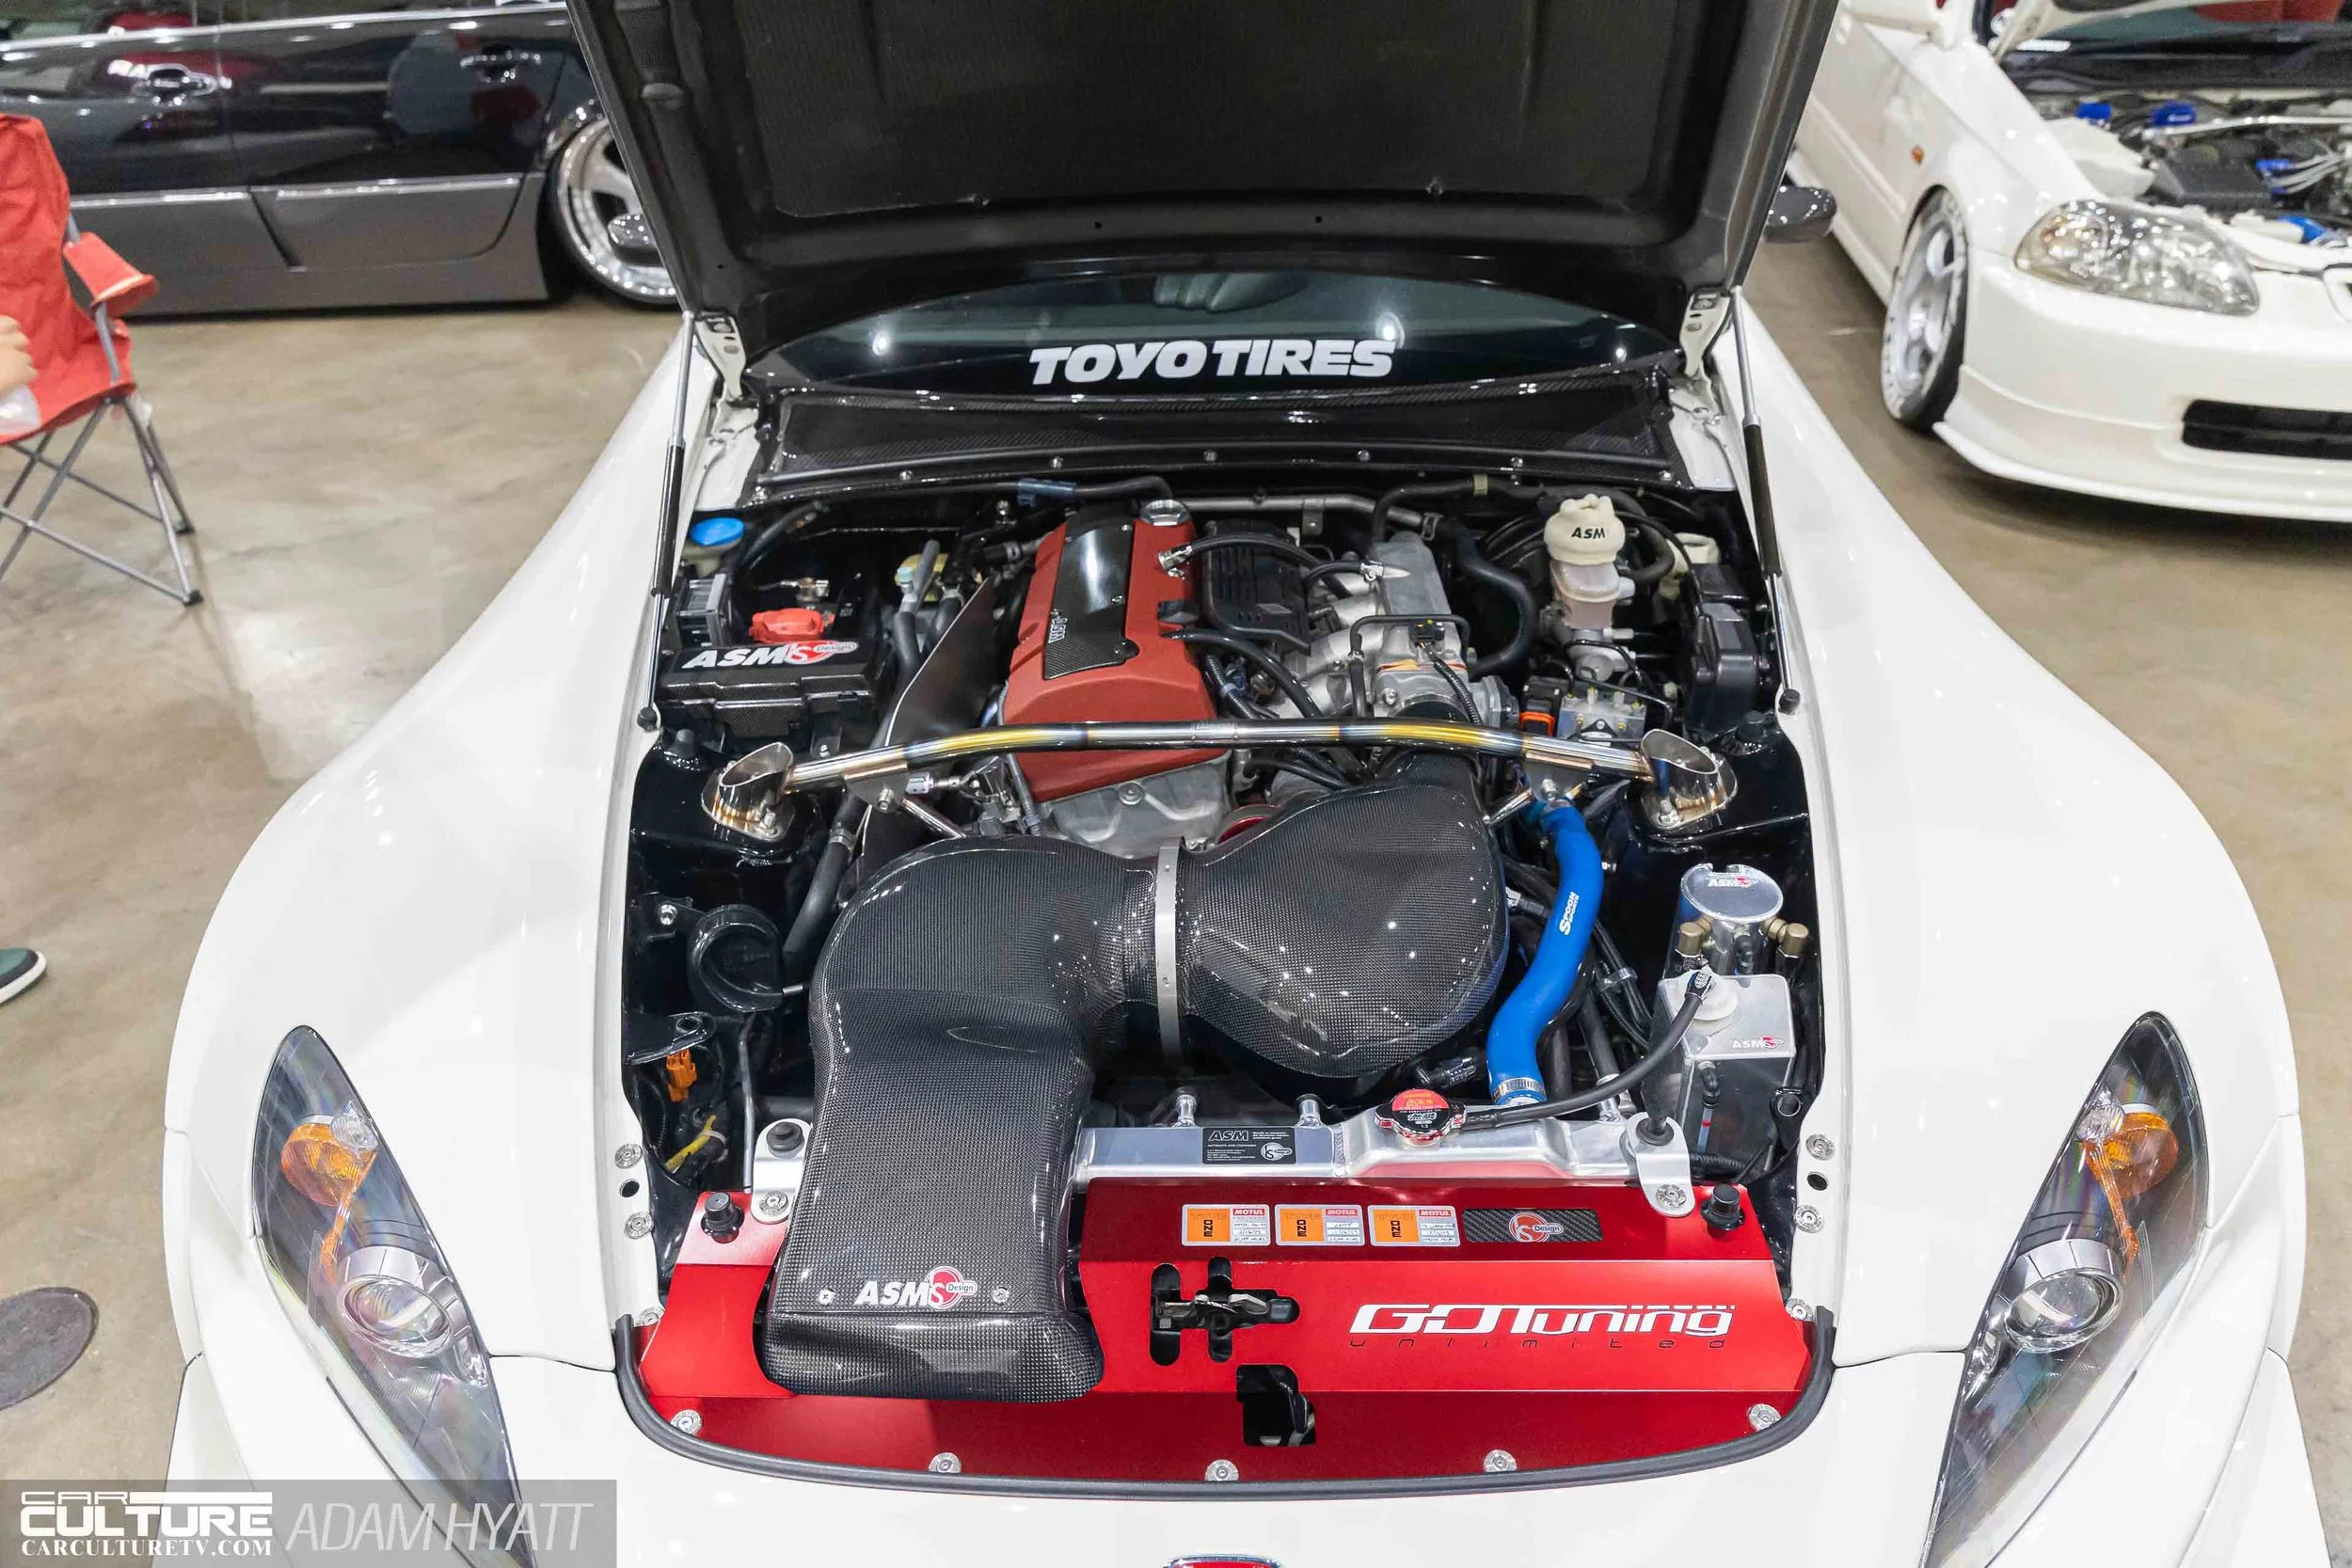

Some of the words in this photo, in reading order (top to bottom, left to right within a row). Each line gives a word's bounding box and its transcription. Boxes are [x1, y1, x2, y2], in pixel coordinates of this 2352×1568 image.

[1029, 341, 1207, 386] TOYO
[1211, 339, 1395, 378] TIRES
[1570, 527, 1606, 539] ASM
[681, 646, 786, 670] ASM
[1732, 1039, 1763, 1049] ASM
[1208, 1131, 1249, 1142] ASM
[1203, 1219, 1214, 1238] ONE
[1296, 1219, 1307, 1238] ONE
[1391, 1220, 1402, 1238] ONE
[1534, 1225, 1560, 1233] Design
[852, 1280, 930, 1307] ASM
[947, 1283, 974, 1292] Design
[1348, 1303, 1737, 1338] GOTuning
